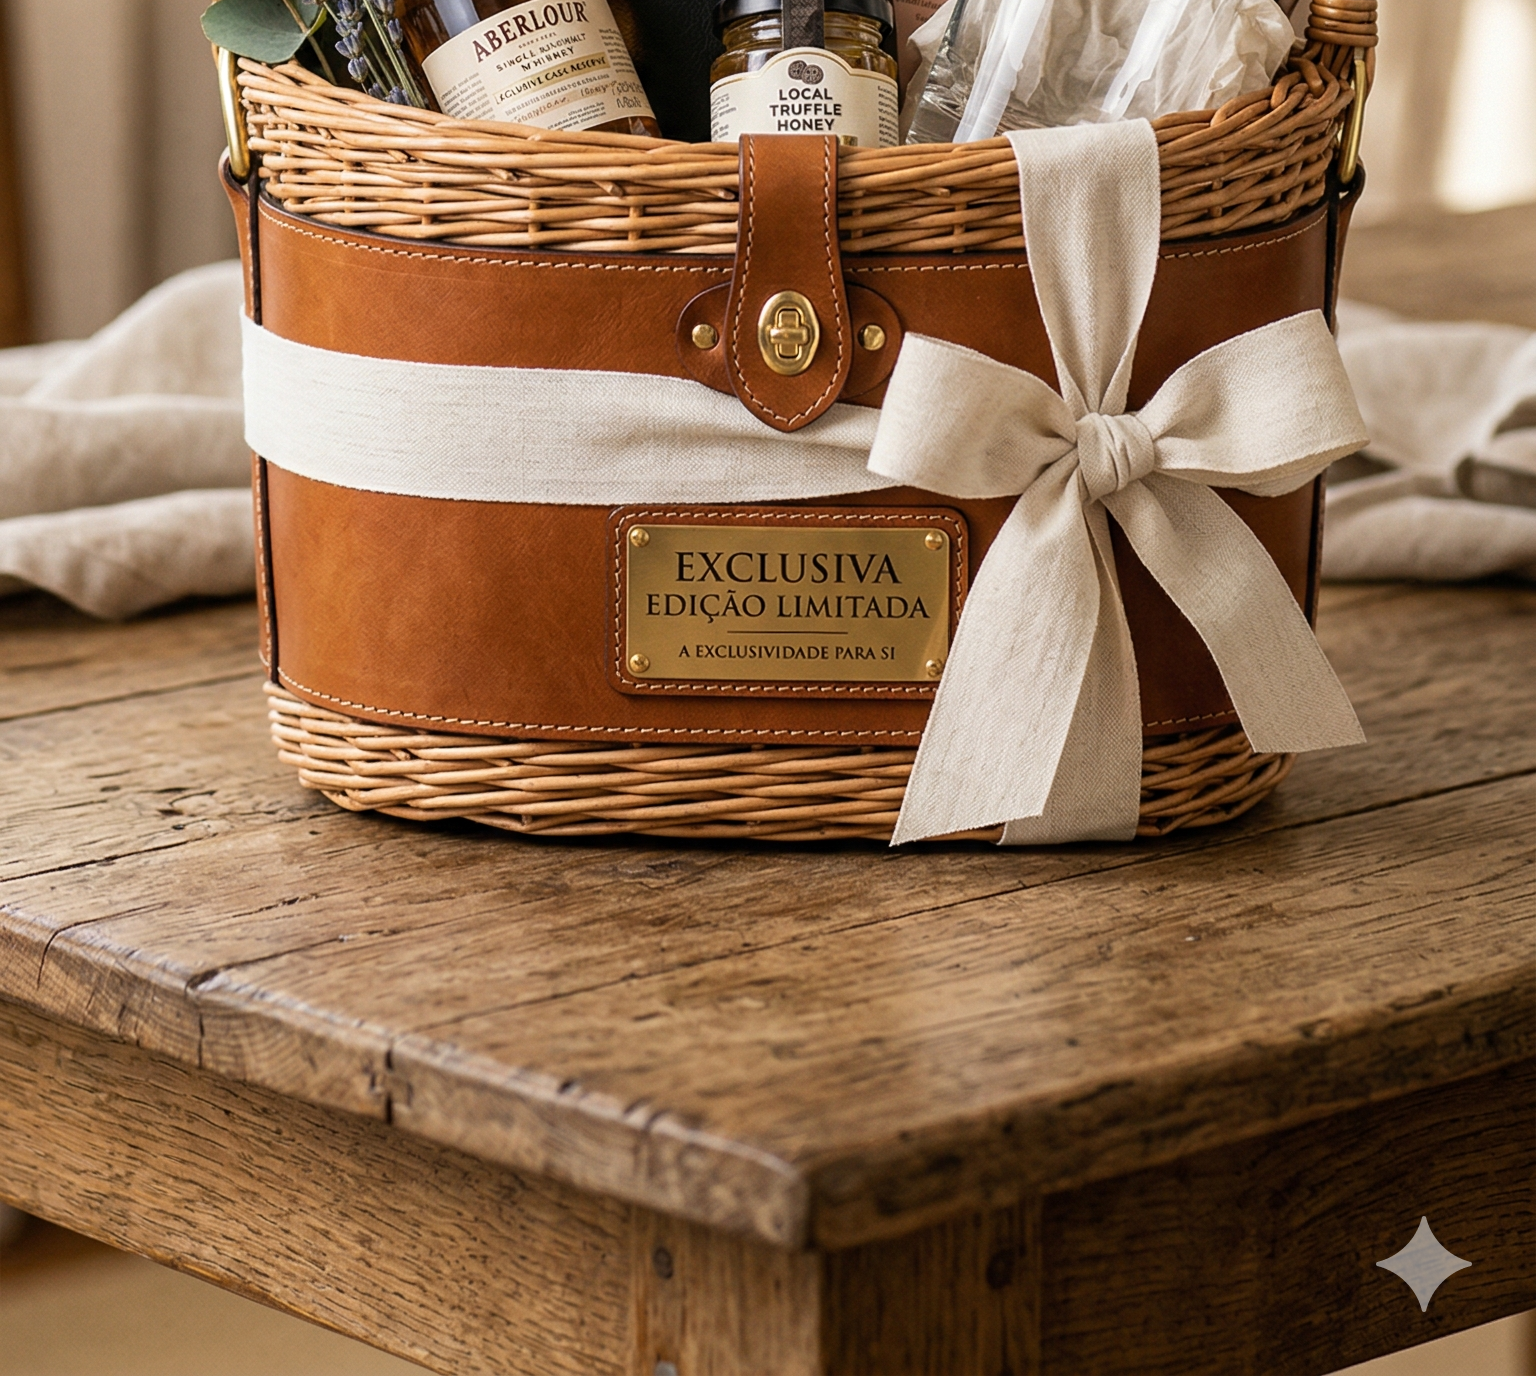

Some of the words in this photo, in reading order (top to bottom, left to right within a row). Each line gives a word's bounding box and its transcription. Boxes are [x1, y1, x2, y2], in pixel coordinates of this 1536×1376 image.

[472, 1, 589, 63] ABERLOUR
[779, 88, 833, 101] LOCAL
[770, 103, 842, 116] TRUFFLE
[778, 119, 835, 131] HONEY
[675, 551, 902, 584] EXCLUSIVA
[646, 590, 766, 623] EDIÇÃO
[777, 595, 931, 619] LIMITADA
[678, 645, 690, 658] A
[696, 645, 829, 660] EXCLUSIVIDADE
[835, 646, 876, 660] PARA
[881, 646, 895, 660] SI
